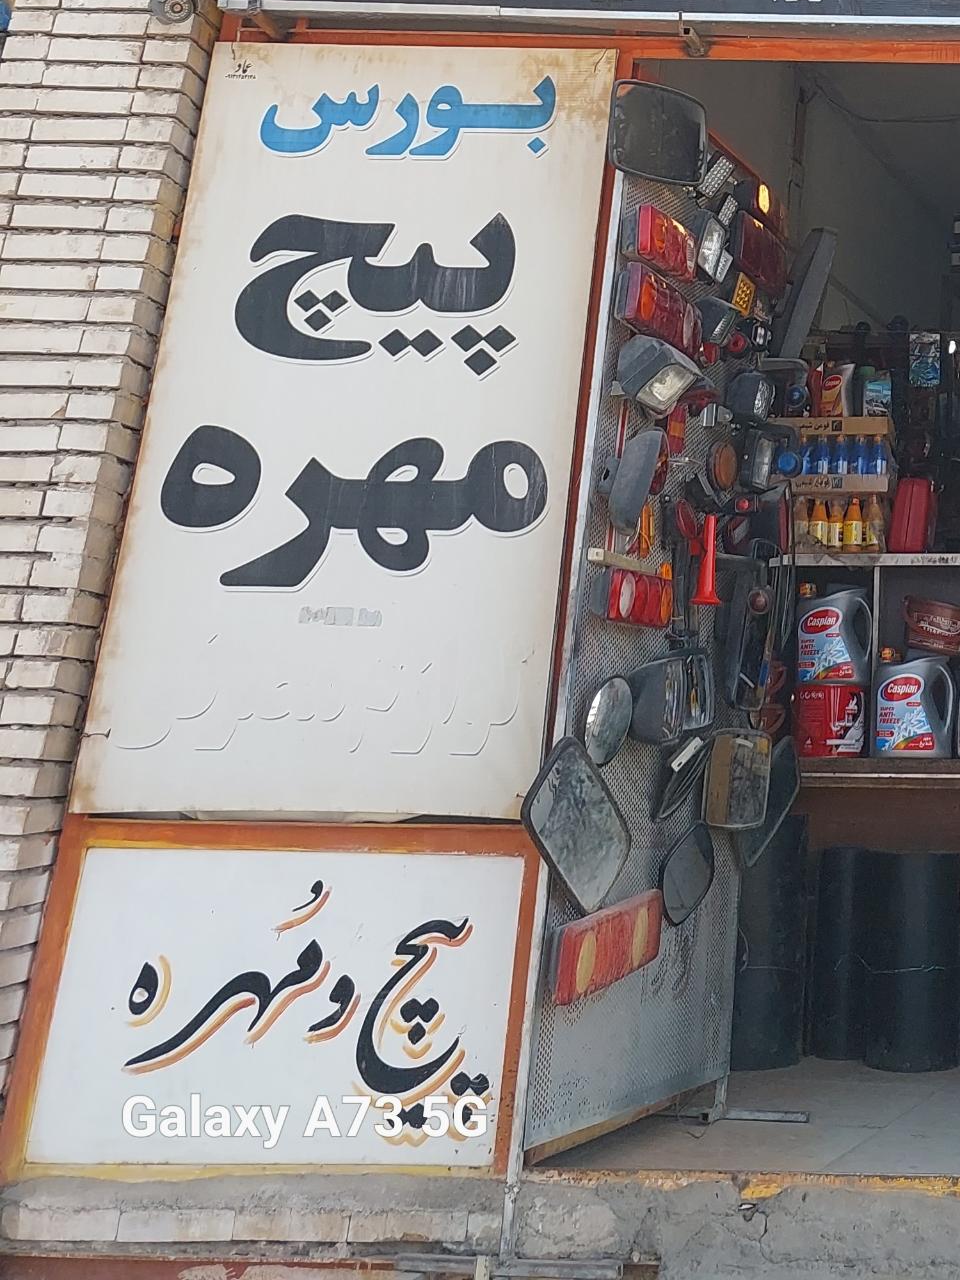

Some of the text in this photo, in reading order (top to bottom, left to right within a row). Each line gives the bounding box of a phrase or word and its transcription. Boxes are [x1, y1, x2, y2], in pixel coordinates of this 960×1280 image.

[260, 74, 556, 158] بورس
[234, 211, 517, 377] پیچ
[160, 424, 549, 590] مهره
[807, 615, 836, 627] Caspian
[887, 683, 918, 695] Caspian
